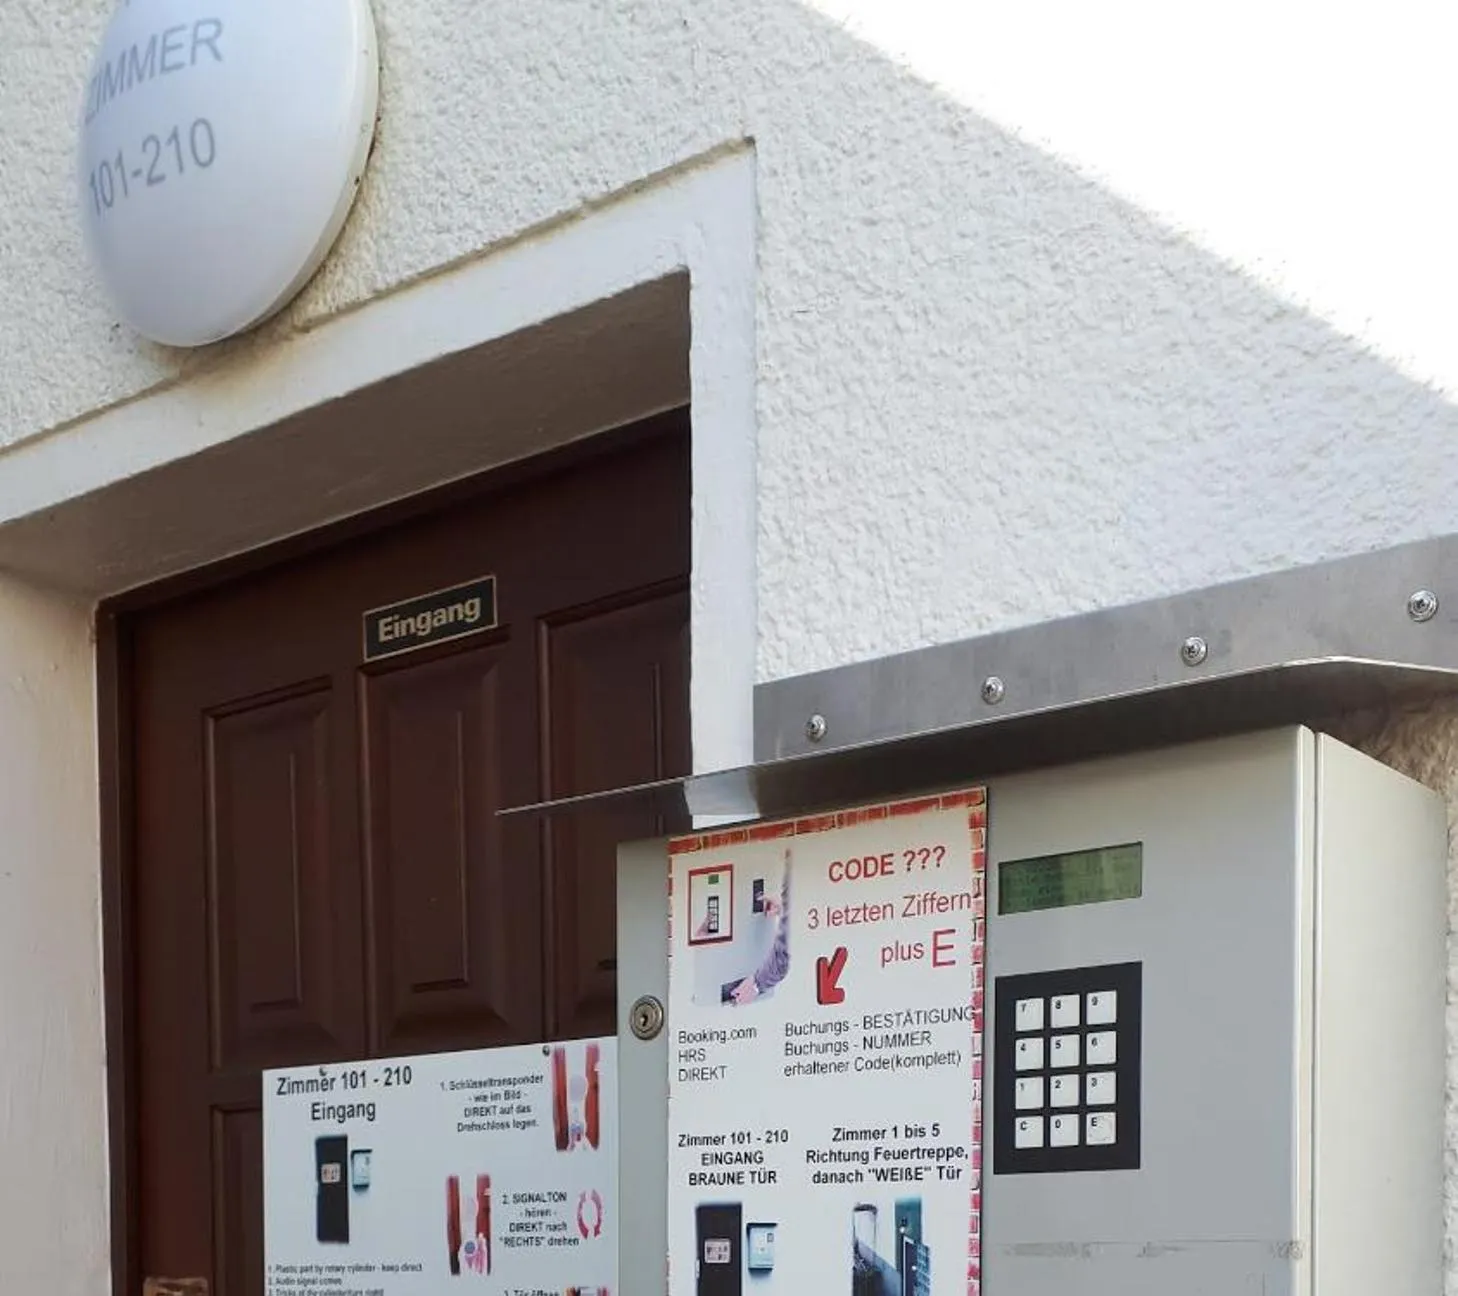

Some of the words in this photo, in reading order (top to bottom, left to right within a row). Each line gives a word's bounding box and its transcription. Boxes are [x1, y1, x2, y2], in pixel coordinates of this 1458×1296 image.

[89, 117, 216, 216] 101-210
[378, 597, 481, 643] Eingang
[828, 853, 895, 883] CODE
[903, 845, 946, 872] ???
[807, 908, 820, 930] 3
[826, 901, 894, 928] letzten
[902, 892, 971, 918] Ziffern
[880, 939, 924, 967] plus
[932, 928, 956, 968] E
[1055, 1000, 1062, 1009] 8
[1091, 996, 1098, 1006] 9
[785, 1019, 849, 1037] Buchungs
[863, 1005, 976, 1030] BESTÄTIGUNG
[678, 1025, 757, 1045] Booking.com
[784, 1039, 849, 1057] Buchungs
[863, 1030, 932, 1051] NUMMER
[1020, 1043, 1026, 1051] 4
[1055, 1040, 1061, 1049] 5
[1091, 1037, 1098, 1047] 6
[678, 1048, 706, 1063] HRS
[783, 1059, 849, 1077] erhaltener
[854, 1050, 962, 1073] Code(komplett)
[276, 1076, 336, 1096] Zimmer
[341, 1069, 367, 1089] 101
[383, 1065, 412, 1086] 210
[678, 1065, 728, 1083] DIREKT
[1055, 1079, 1061, 1089] 2
[1091, 1078, 1098, 1087] 3
[311, 1102, 376, 1124] Eingang
[464, 1105, 498, 1118] DIREKT
[499, 1104, 513, 1115] auf
[515, 1104, 532, 1114] das
[832, 1127, 887, 1143] Zimmer
[892, 1126, 898, 1140] 1
[904, 1124, 927, 1139] bis
[931, 1123, 941, 1137] 5
[1020, 1121, 1027, 1131] C
[1091, 1117, 1097, 1127] E
[678, 1132, 726, 1148] Zimmer
[730, 1131, 751, 1145] 101
[766, 1129, 789, 1144] 210
[701, 1151, 764, 1167] EINGANG
[806, 1147, 869, 1165] Richtung
[874, 1145, 969, 1162] Feuertreppe,
[688, 1171, 745, 1187] BRAUNE
[750, 1167, 777, 1185] TÜR
[812, 1169, 863, 1184] danach
[936, 1165, 963, 1181] Tür
[512, 1191, 567, 1204] SIGNALTON
[509, 1221, 544, 1232] DIREKT
[547, 1236, 580, 1246] drehen
